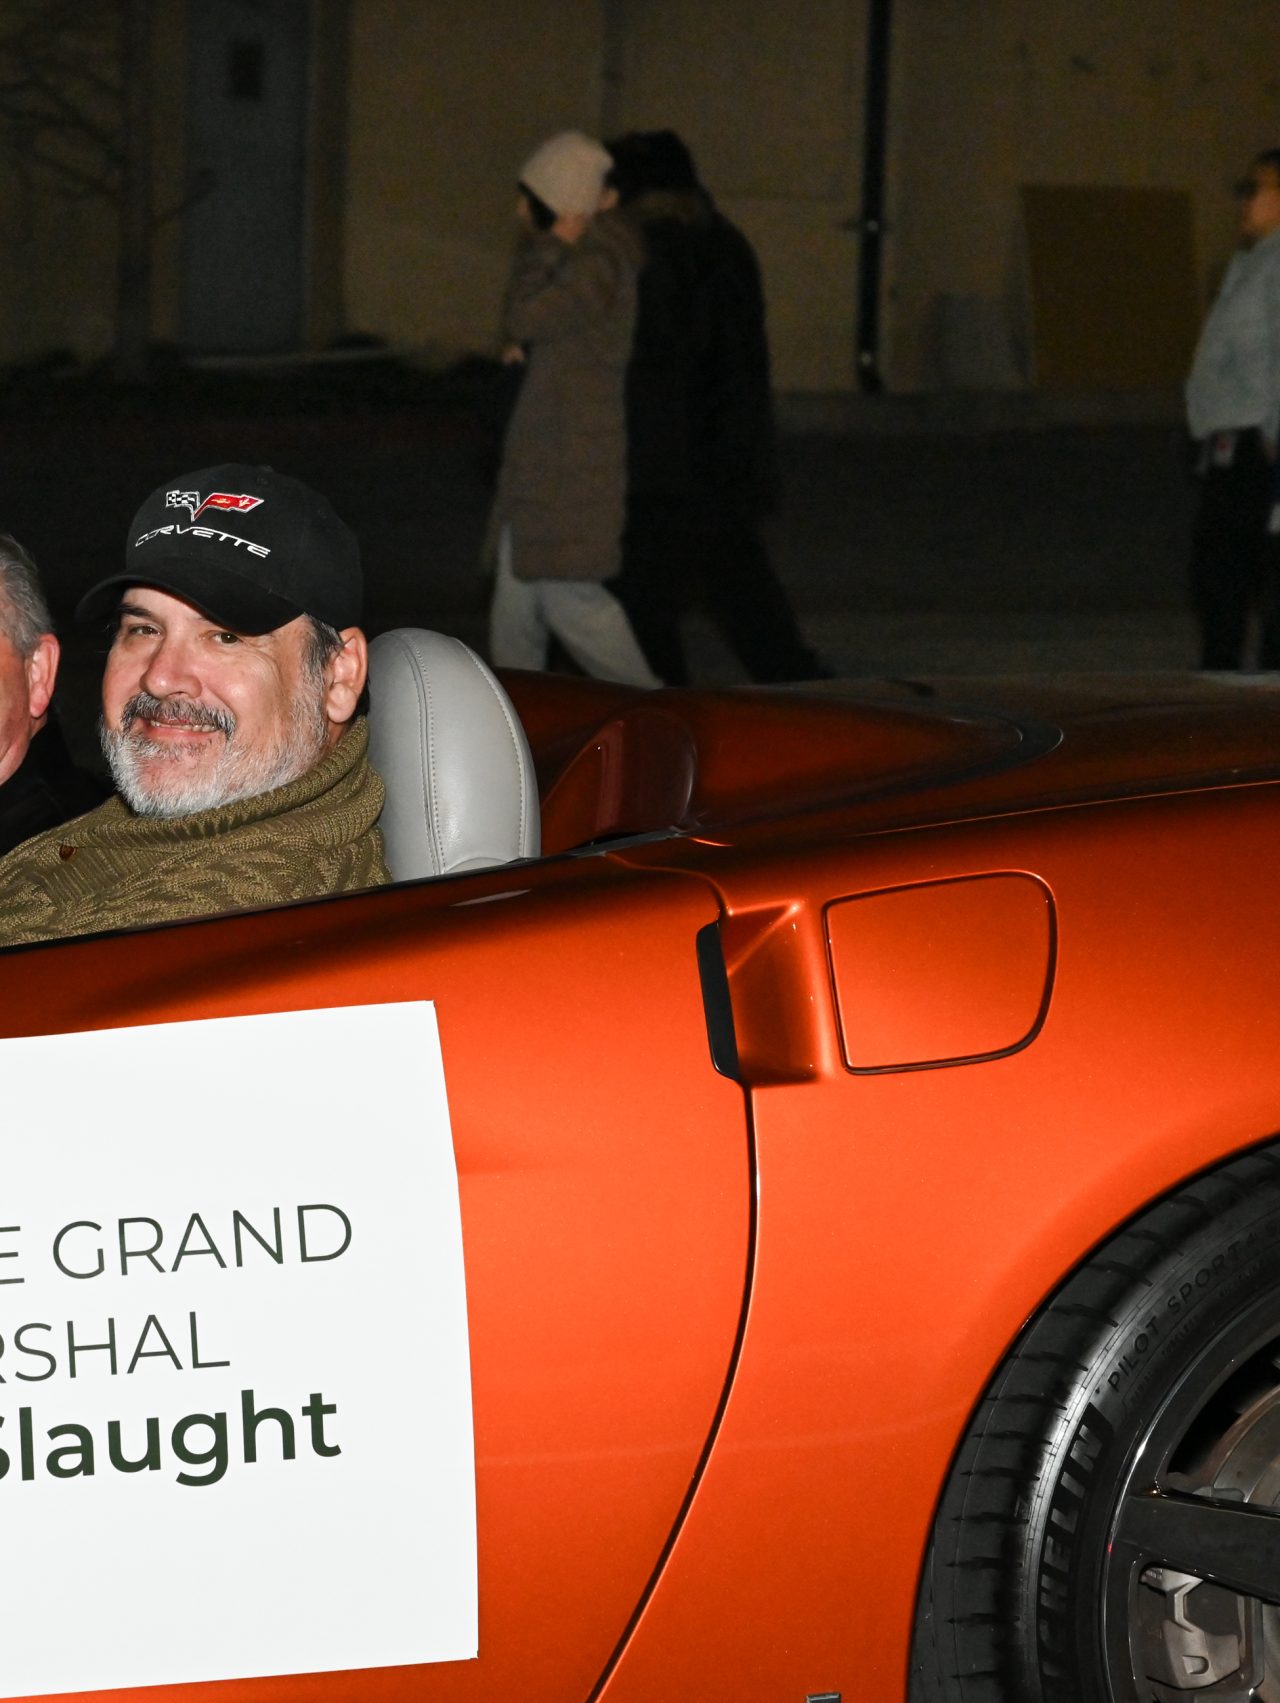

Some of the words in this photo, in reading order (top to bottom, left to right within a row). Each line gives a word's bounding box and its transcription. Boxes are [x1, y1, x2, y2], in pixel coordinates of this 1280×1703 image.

[135, 524, 271, 558] CORVETTE
[52, 1203, 353, 1280] GRAND
[1108, 1316, 1159, 1393] PILOT
[1168, 1241, 1242, 1314] SPORT
